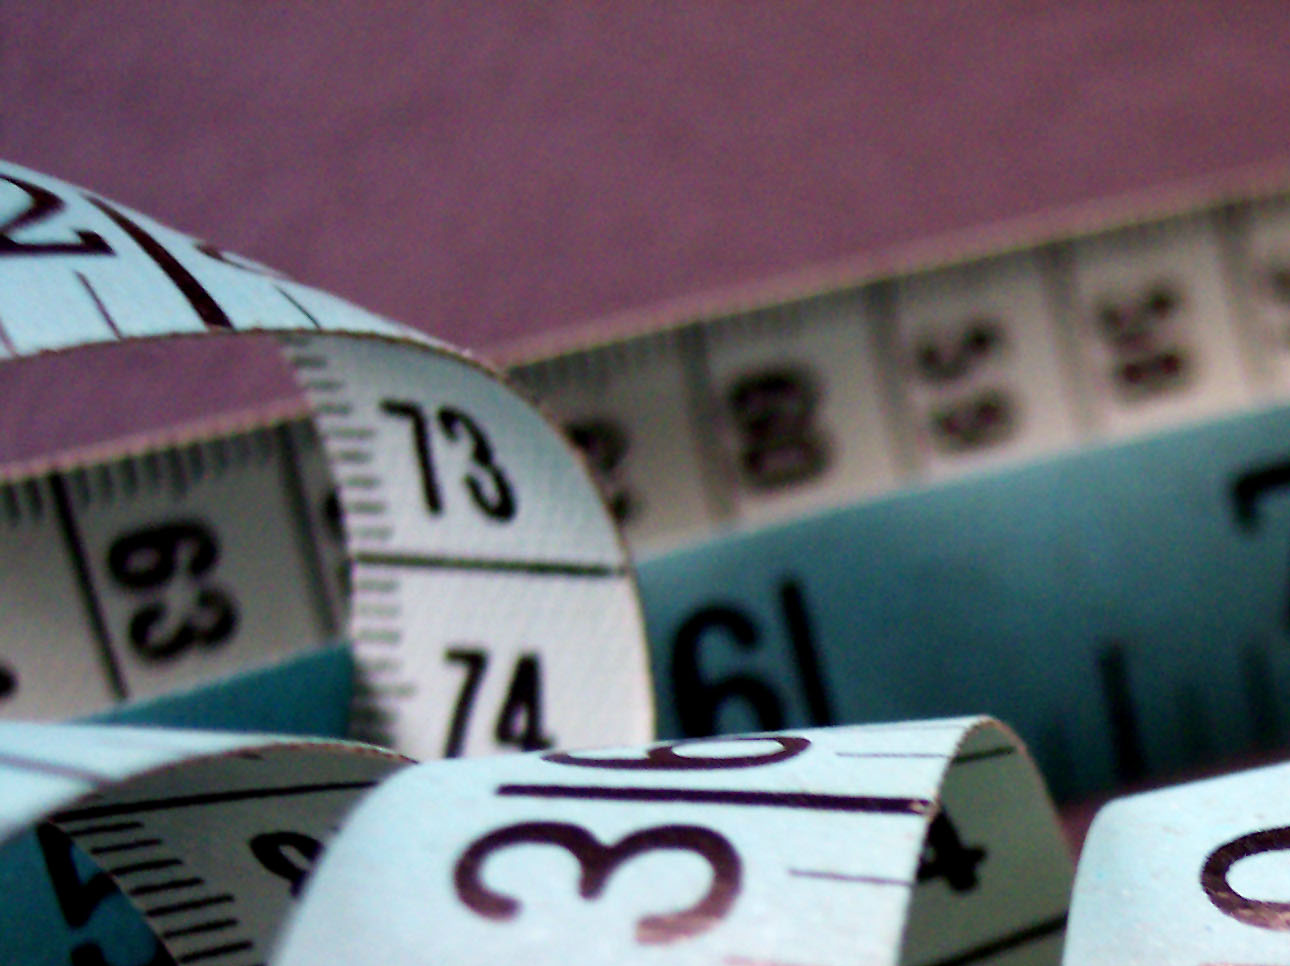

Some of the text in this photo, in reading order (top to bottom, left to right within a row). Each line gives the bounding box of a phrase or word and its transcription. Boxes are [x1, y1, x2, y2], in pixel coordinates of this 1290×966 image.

[380, 398, 518, 523] 73
[107, 517, 241, 664] 63
[444, 646, 553, 757] 74
[670, 605, 783, 738] 6
